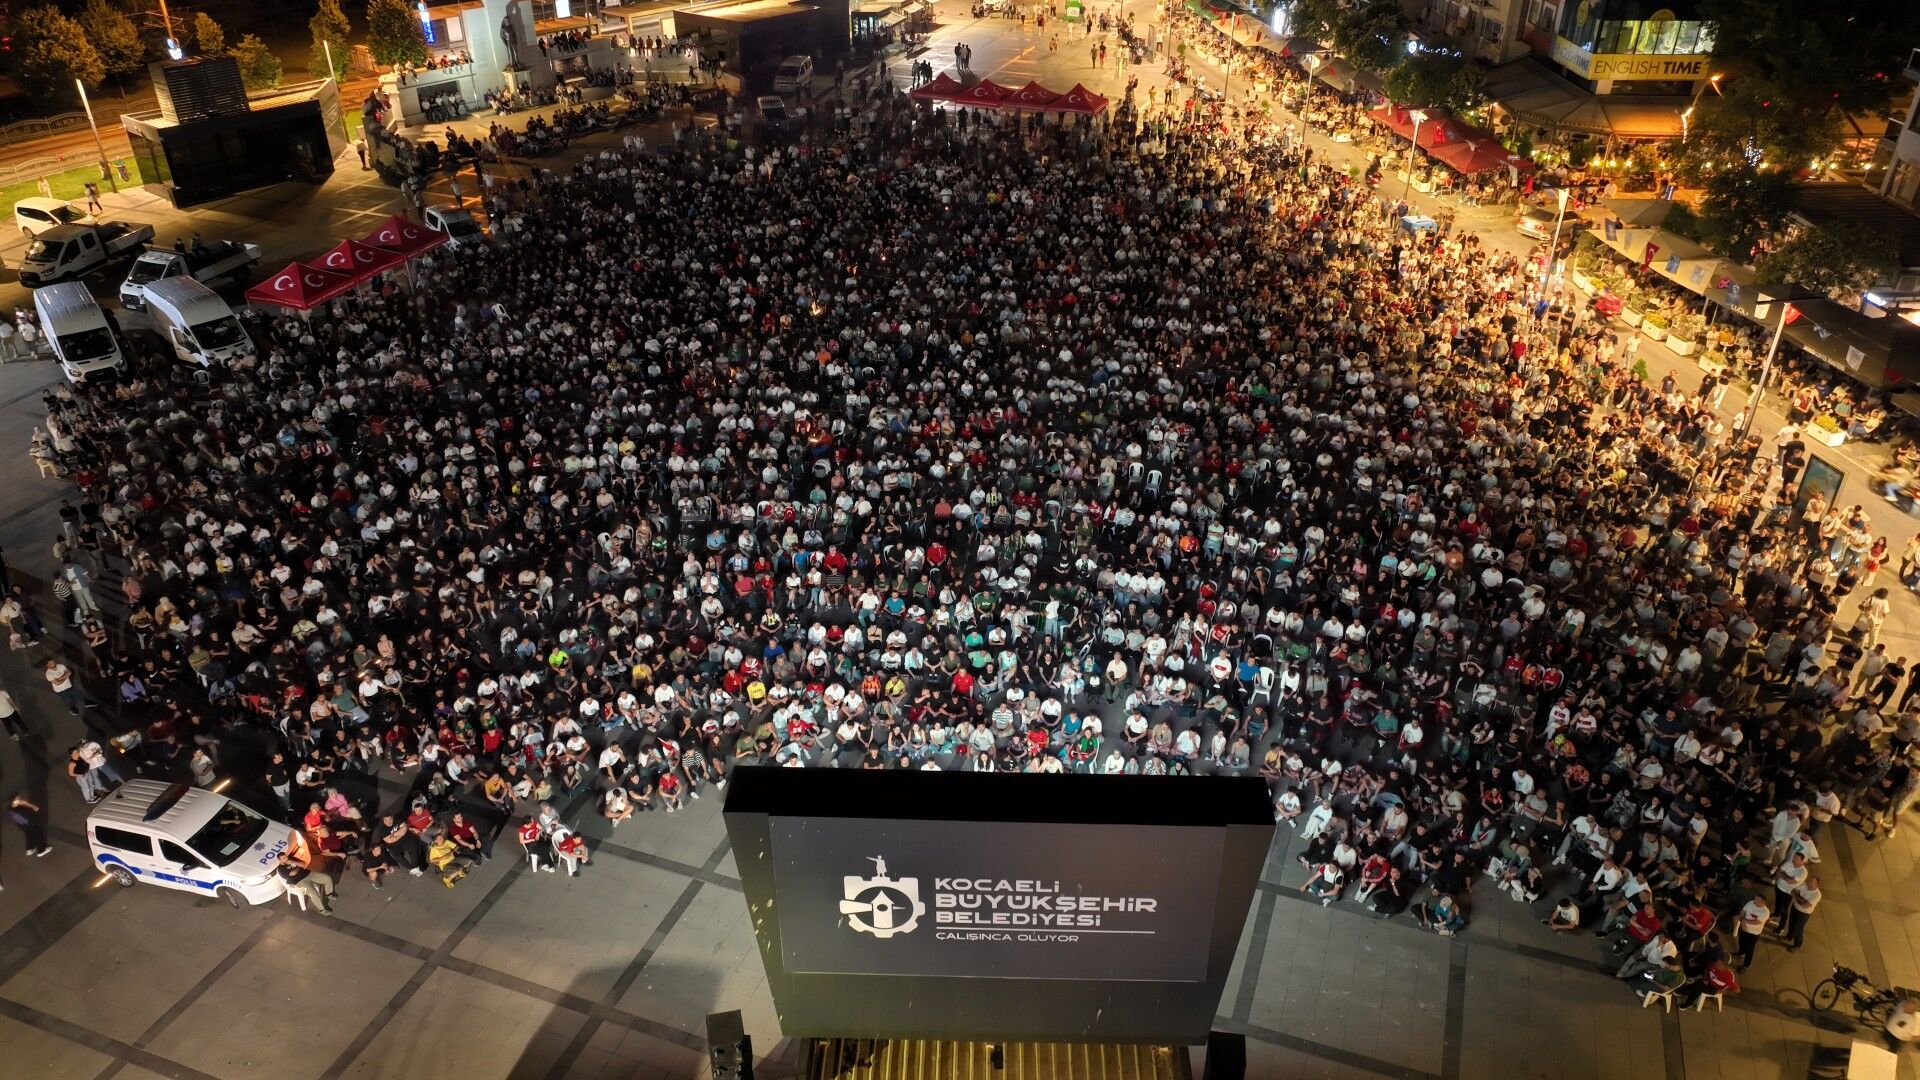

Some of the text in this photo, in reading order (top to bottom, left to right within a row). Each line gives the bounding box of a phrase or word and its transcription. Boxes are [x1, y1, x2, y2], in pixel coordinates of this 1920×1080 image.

[1594, 61, 1702, 75] ENGLISH TIME
[1017, 933, 1079, 942] OLUYOR
